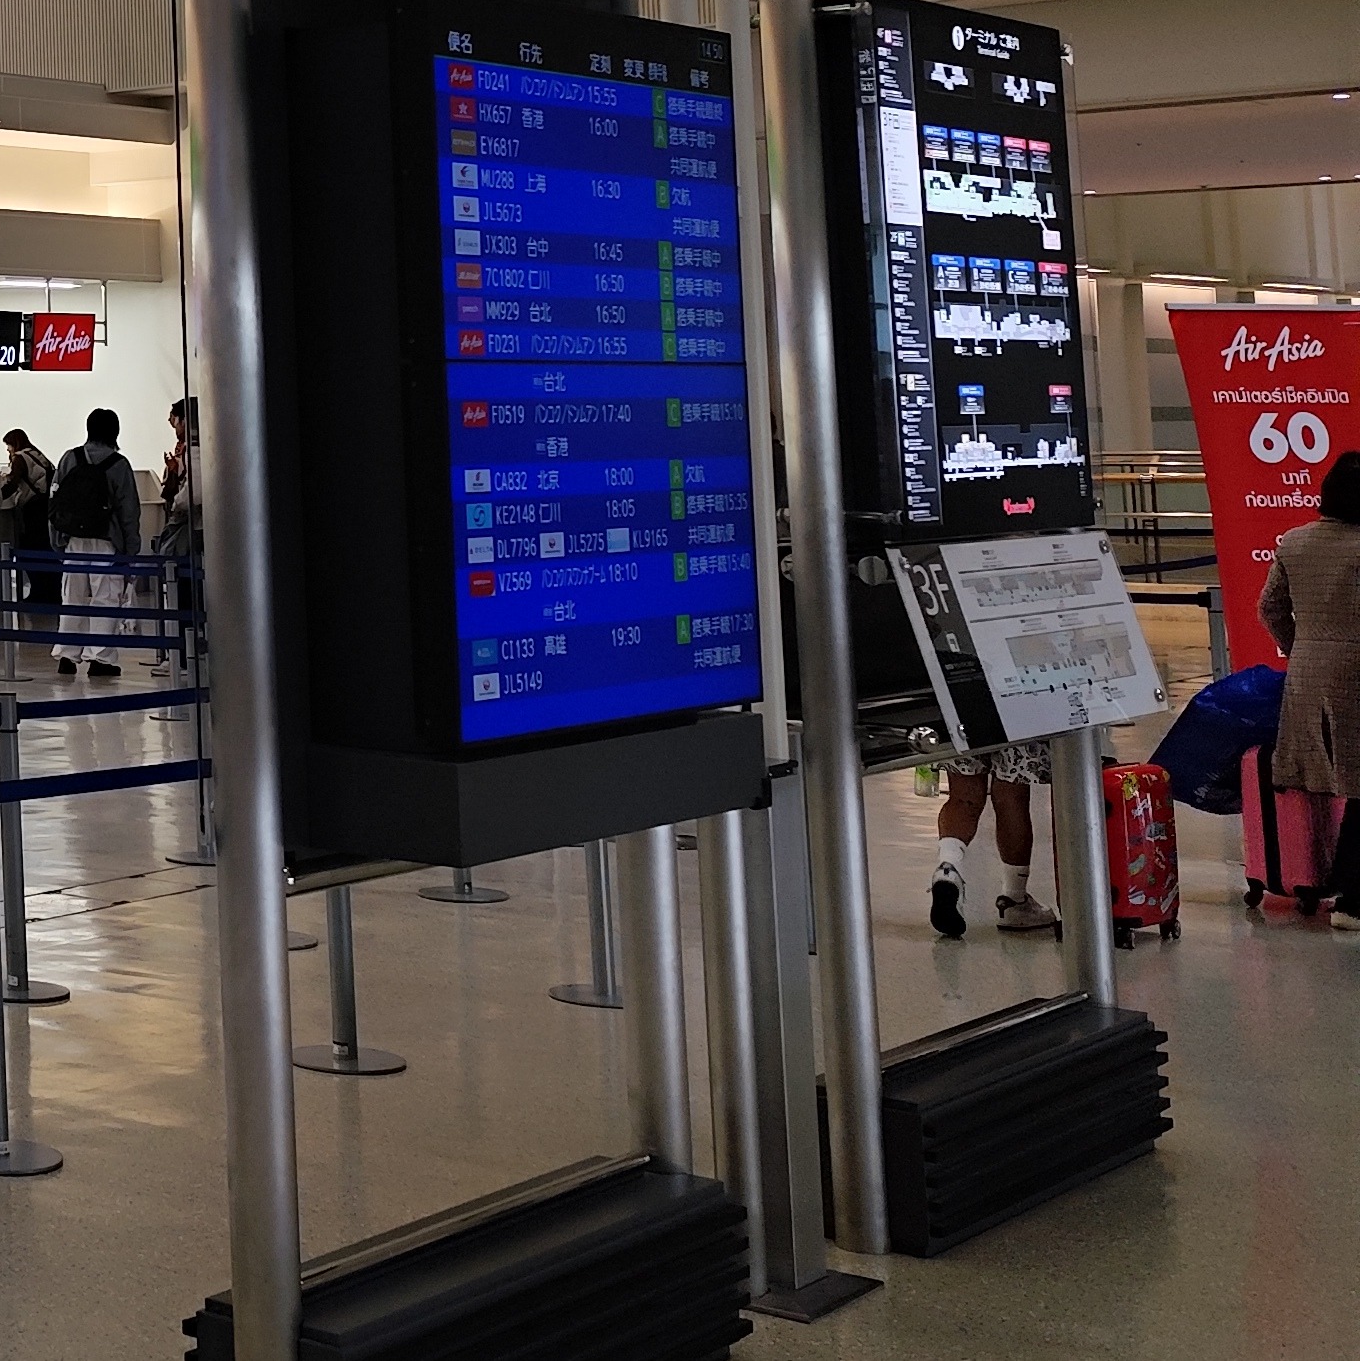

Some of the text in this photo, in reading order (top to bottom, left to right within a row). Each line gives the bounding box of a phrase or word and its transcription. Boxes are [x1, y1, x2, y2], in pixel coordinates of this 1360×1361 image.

[448, 30, 473, 54] 便名
[519, 42, 543, 65] 行先
[589, 53, 612, 75] 定刻
[690, 69, 710, 89] 備考
[478, 70, 618, 106] FD241 15:55
[479, 103, 619, 137] HX657 香港 16:00
[480, 136, 520, 157] EY6817
[481, 168, 515, 190] MU288
[525, 174, 547, 194] 上海
[591, 179, 621, 199] 16:30
[483, 201, 523, 223] JL5673
[484, 235, 624, 262] JX303 台中 16:45
[485, 268, 625, 293] 7C1802 仁川 16:50
[485, 301, 626, 324] MM929 台北 16:50
[35, 323, 91, 361] AirAsia
[488, 333, 628, 356] FD231 16:55
[1220, 325, 1325, 371] AirAsia
[0, 346, 15, 365] 20
[543, 371, 567, 392] 台北
[491, 402, 631, 425] FD519 17:40
[546, 437, 569, 458] 香港
[1249, 411, 1330, 464] 60
[494, 471, 528, 491] CA832
[536, 469, 560, 490] 北京
[604, 467, 635, 487] 18:00
[1281, 469, 1311, 485] นาที
[495, 499, 636, 525] KE2148 仁川 18:05
[497, 529, 669, 559] DL7796 JL5275 KL9165
[498, 562, 639, 593] VZ569 18:10
[553, 600, 577, 623] 台北
[501, 626, 641, 661] CI133 高雄 19:30
[503, 671, 543, 695] JL5149
